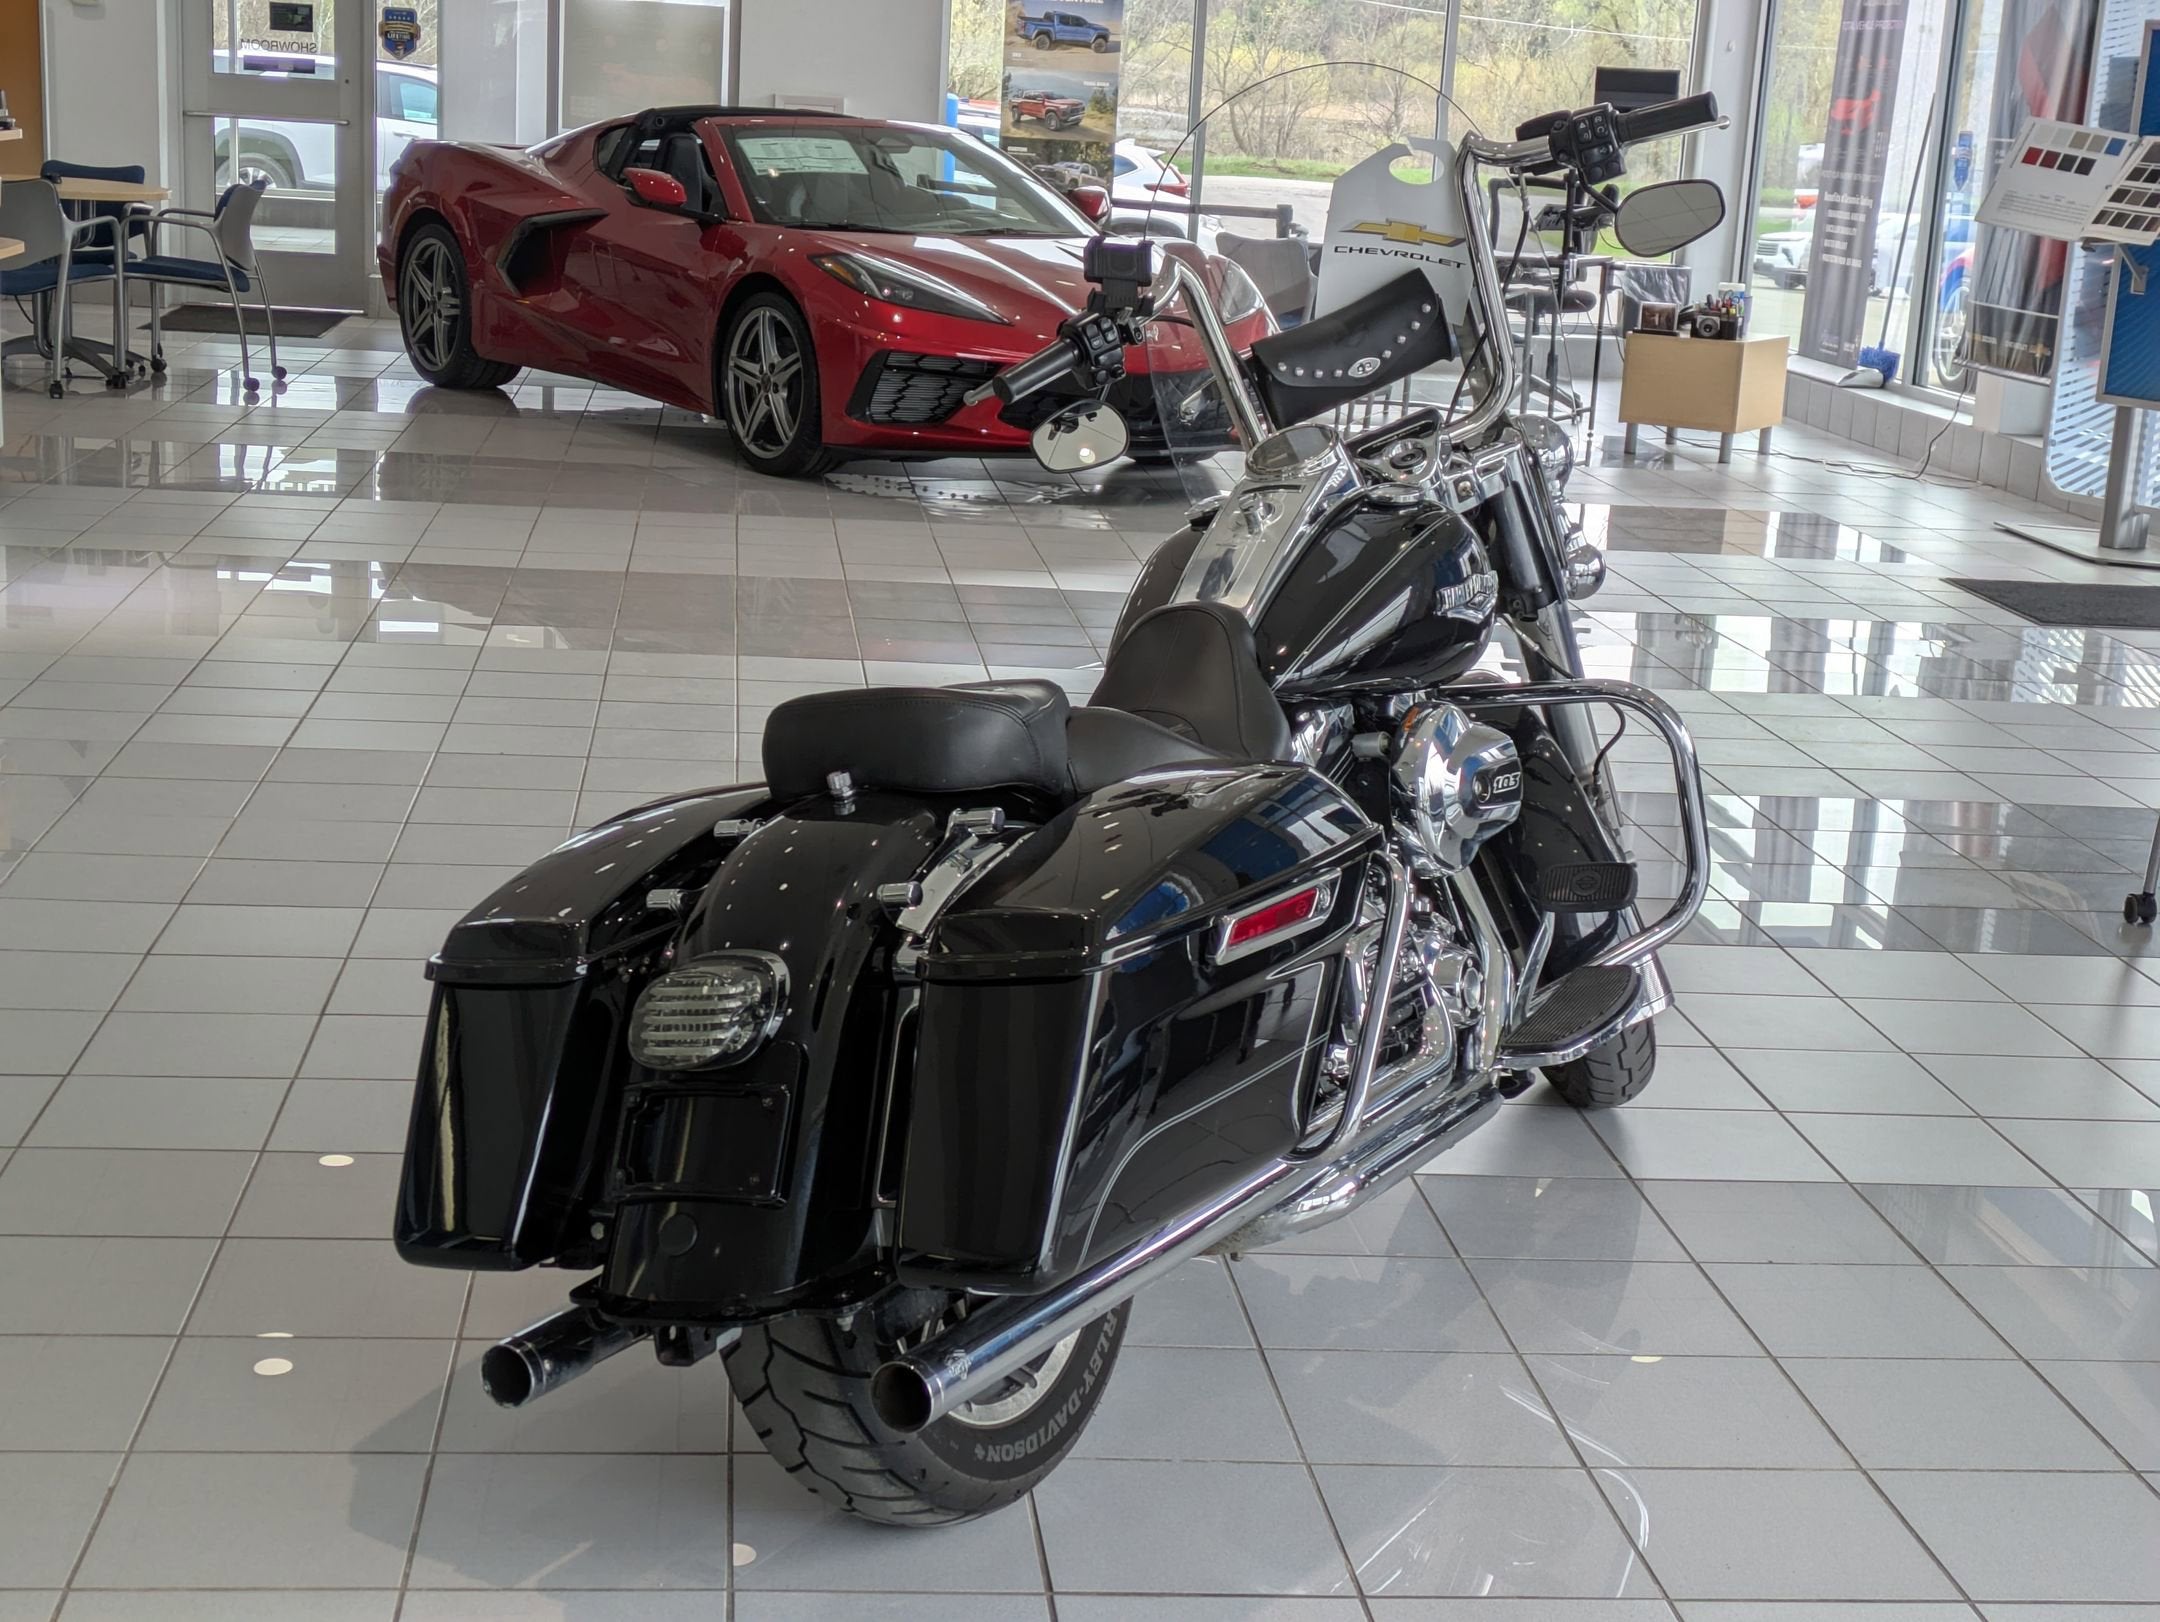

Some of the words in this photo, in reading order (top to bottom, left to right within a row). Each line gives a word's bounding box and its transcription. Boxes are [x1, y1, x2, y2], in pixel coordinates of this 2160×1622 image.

[1334, 245, 1466, 269] CHEVROLET
[1493, 771, 1521, 794] 103
[986, 1308, 1119, 1463] RLEY-DAVIDSON
